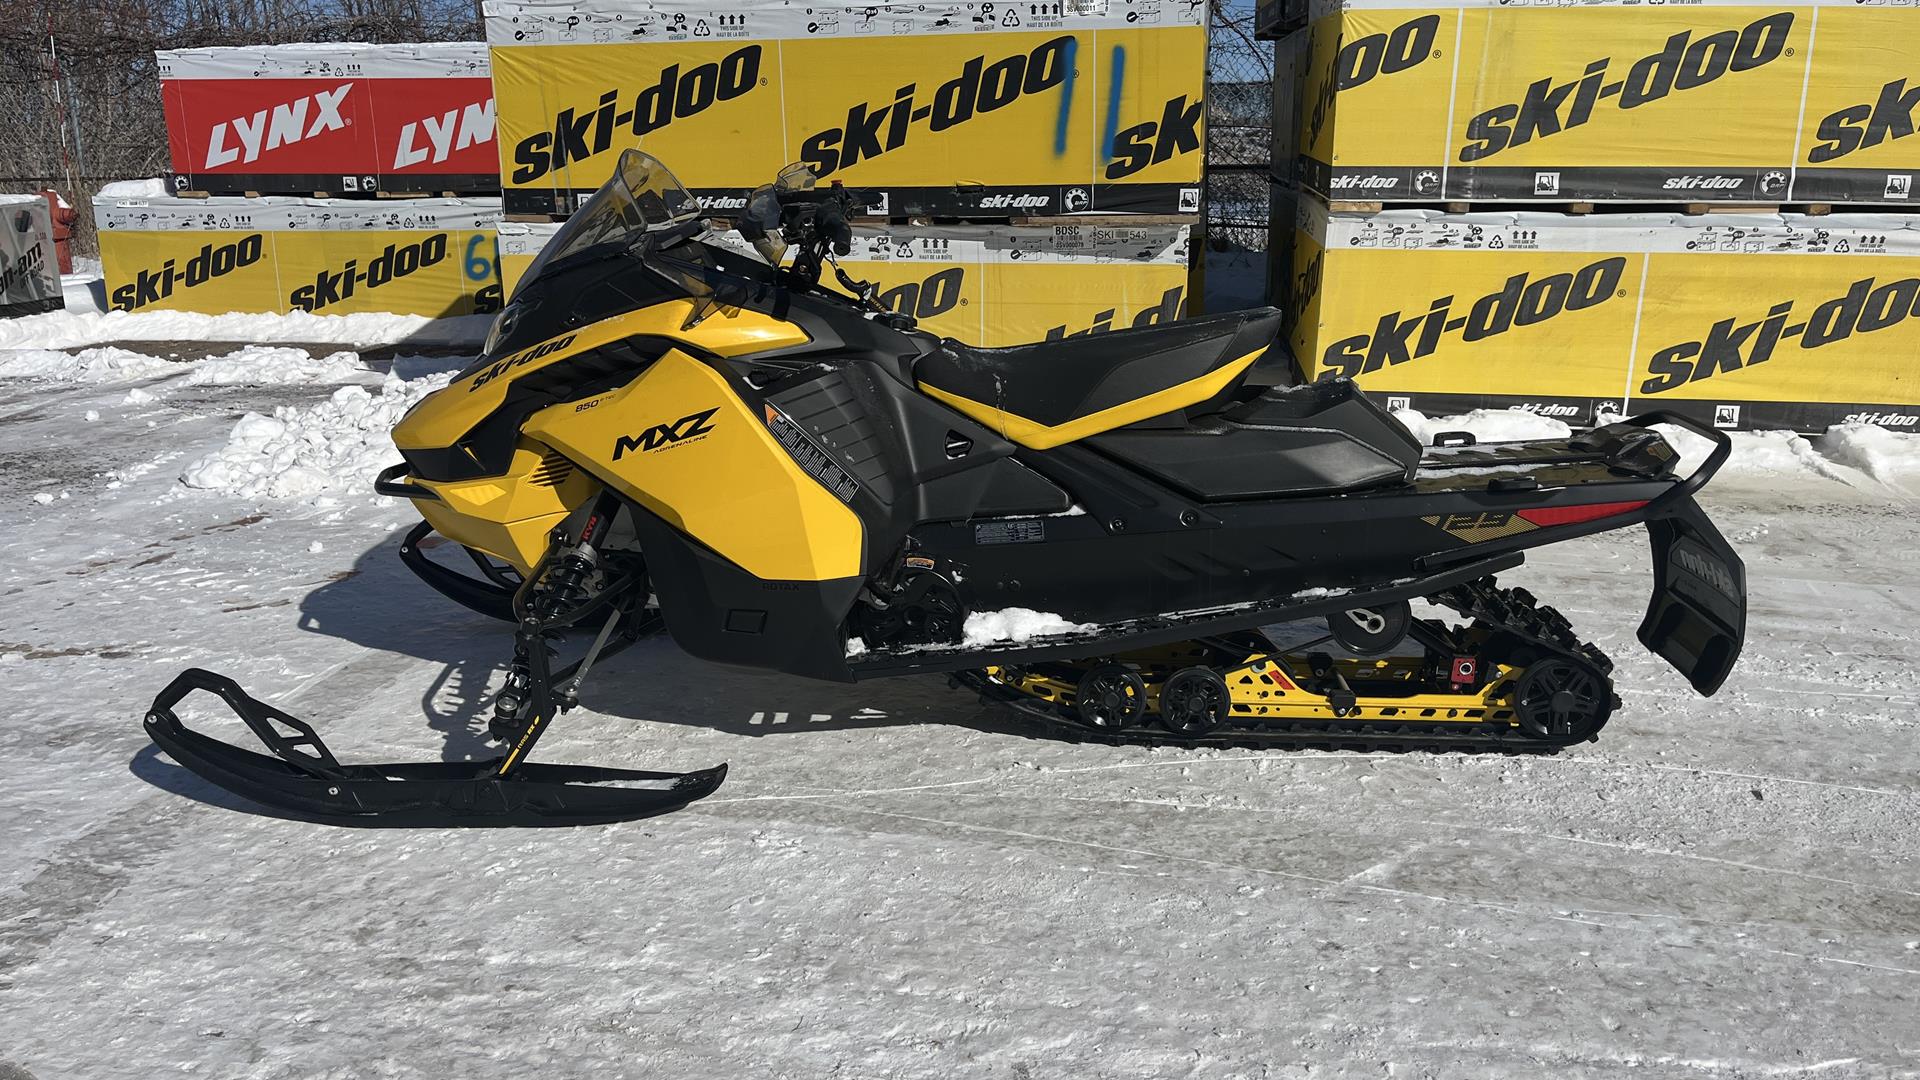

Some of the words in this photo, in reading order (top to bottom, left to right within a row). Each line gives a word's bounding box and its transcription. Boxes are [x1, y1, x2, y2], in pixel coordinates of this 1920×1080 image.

[512, 44, 762, 185] ski-doo
[800, 35, 1076, 181] ski-doo
[1458, 12, 1795, 163] ski-doo
[204, 82, 354, 170] LYNX
[1807, 77, 1920, 164] sk
[979, 194, 1050, 208] ski-doo
[1330, 175, 1399, 189] ski-doo
[1662, 175, 1744, 189] ski-doo
[464, 234, 501, 282] 6
[1055, 226, 1080, 236] BDSC
[1097, 230, 1114, 240] SKI
[1129, 230, 1147, 240] 543
[111, 233, 262, 313] ski-doo
[289, 233, 448, 314] ski-doo
[1316, 257, 1627, 383] ski-doo
[1640, 277, 1920, 394] ski-do
[469, 334, 578, 393] ski-doo
[575, 399, 599, 413] 850
[611, 407, 722, 462] MXZ
[652, 434, 708, 454] ADRENALINE
[762, 582, 800, 592] ROTAX
